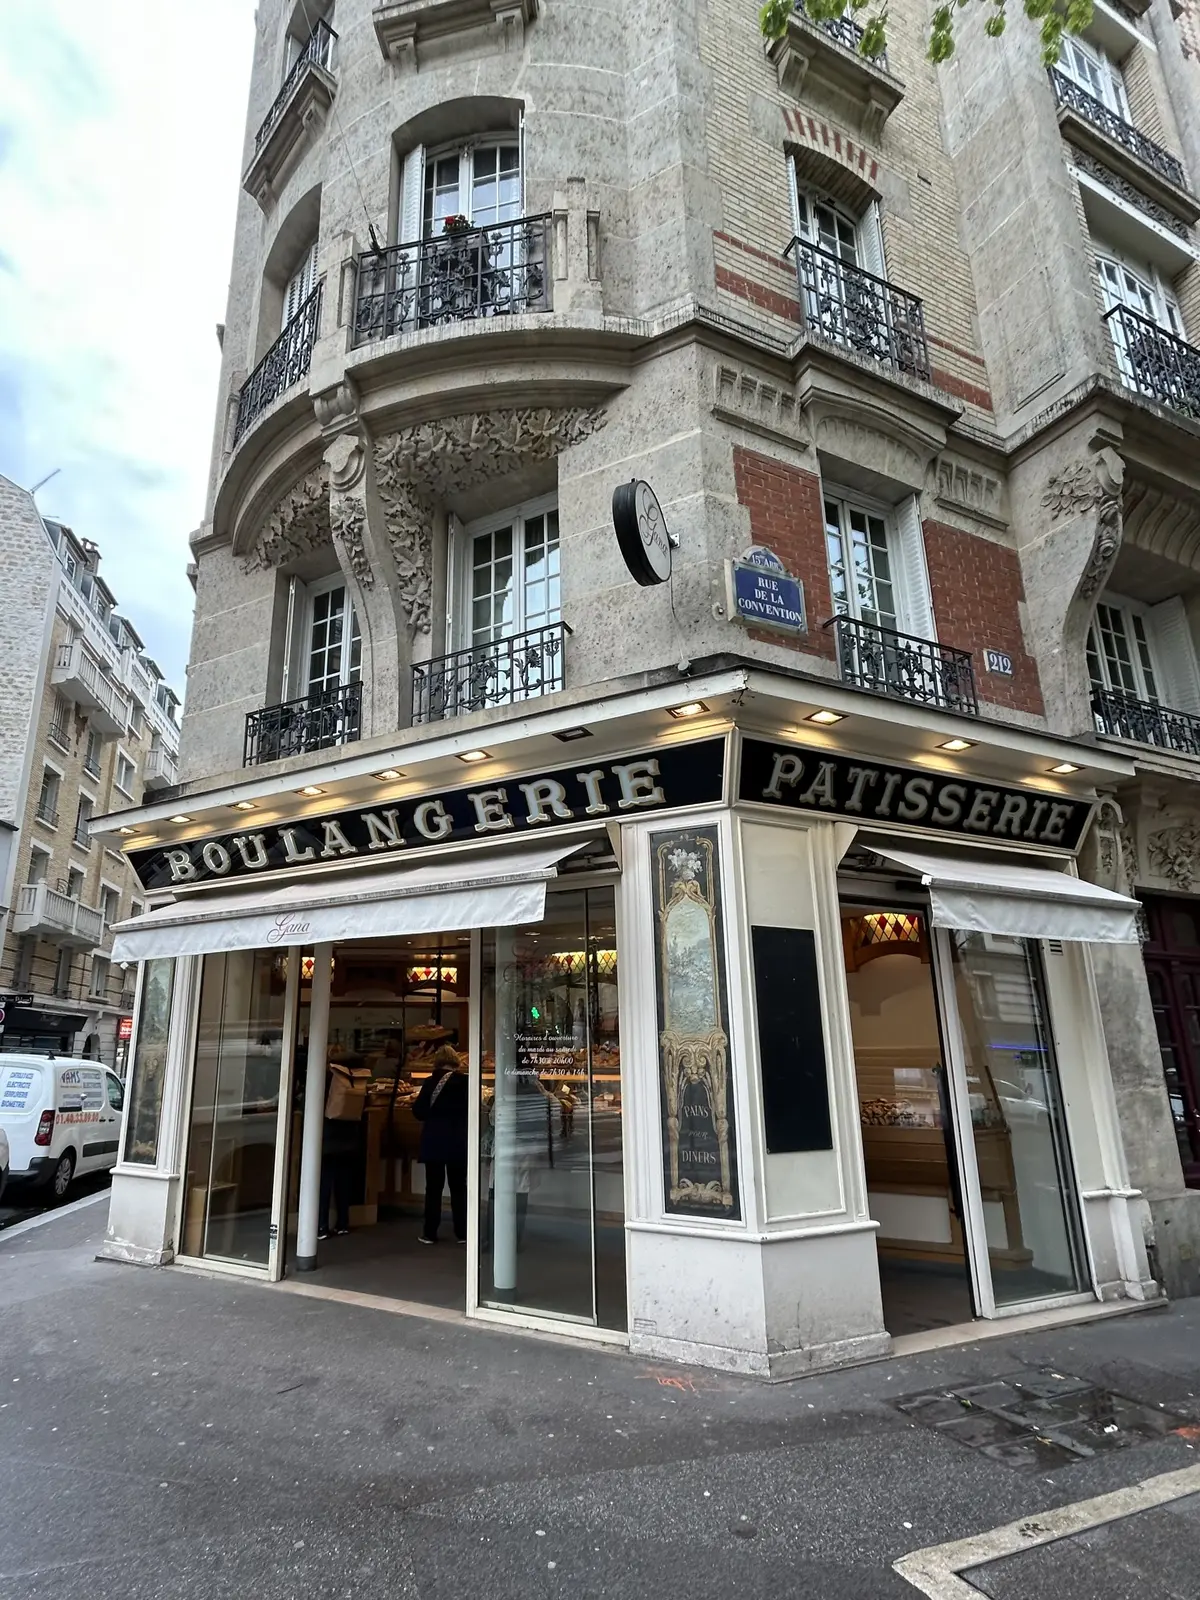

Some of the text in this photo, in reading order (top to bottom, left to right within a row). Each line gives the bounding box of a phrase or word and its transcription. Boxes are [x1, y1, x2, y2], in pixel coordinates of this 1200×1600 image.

[757, 576, 779, 592] RUE
[754, 588, 785, 606] DE LA
[738, 597, 803, 623] CONVENTION
[989, 653, 1013, 675] 212
[762, 752, 1075, 844] PATISSERIE
[162, 757, 667, 884] BOULANGERIE
[266, 910, 312, 944] Gana
[513, 1033, 544, 1041] Horaires
[518, 1045, 527, 1053] du
[527, 1045, 546, 1053] mardi
[521, 1056, 530, 1064] de
[552, 1056, 574, 1065] 20h00
[504, 1067, 511, 1077] le
[511, 1067, 540, 1077] dimanche
[540, 1068, 548, 1076] de
[683, 1105, 709, 1119] PAINS
[682, 1150, 717, 1165] DINERS
